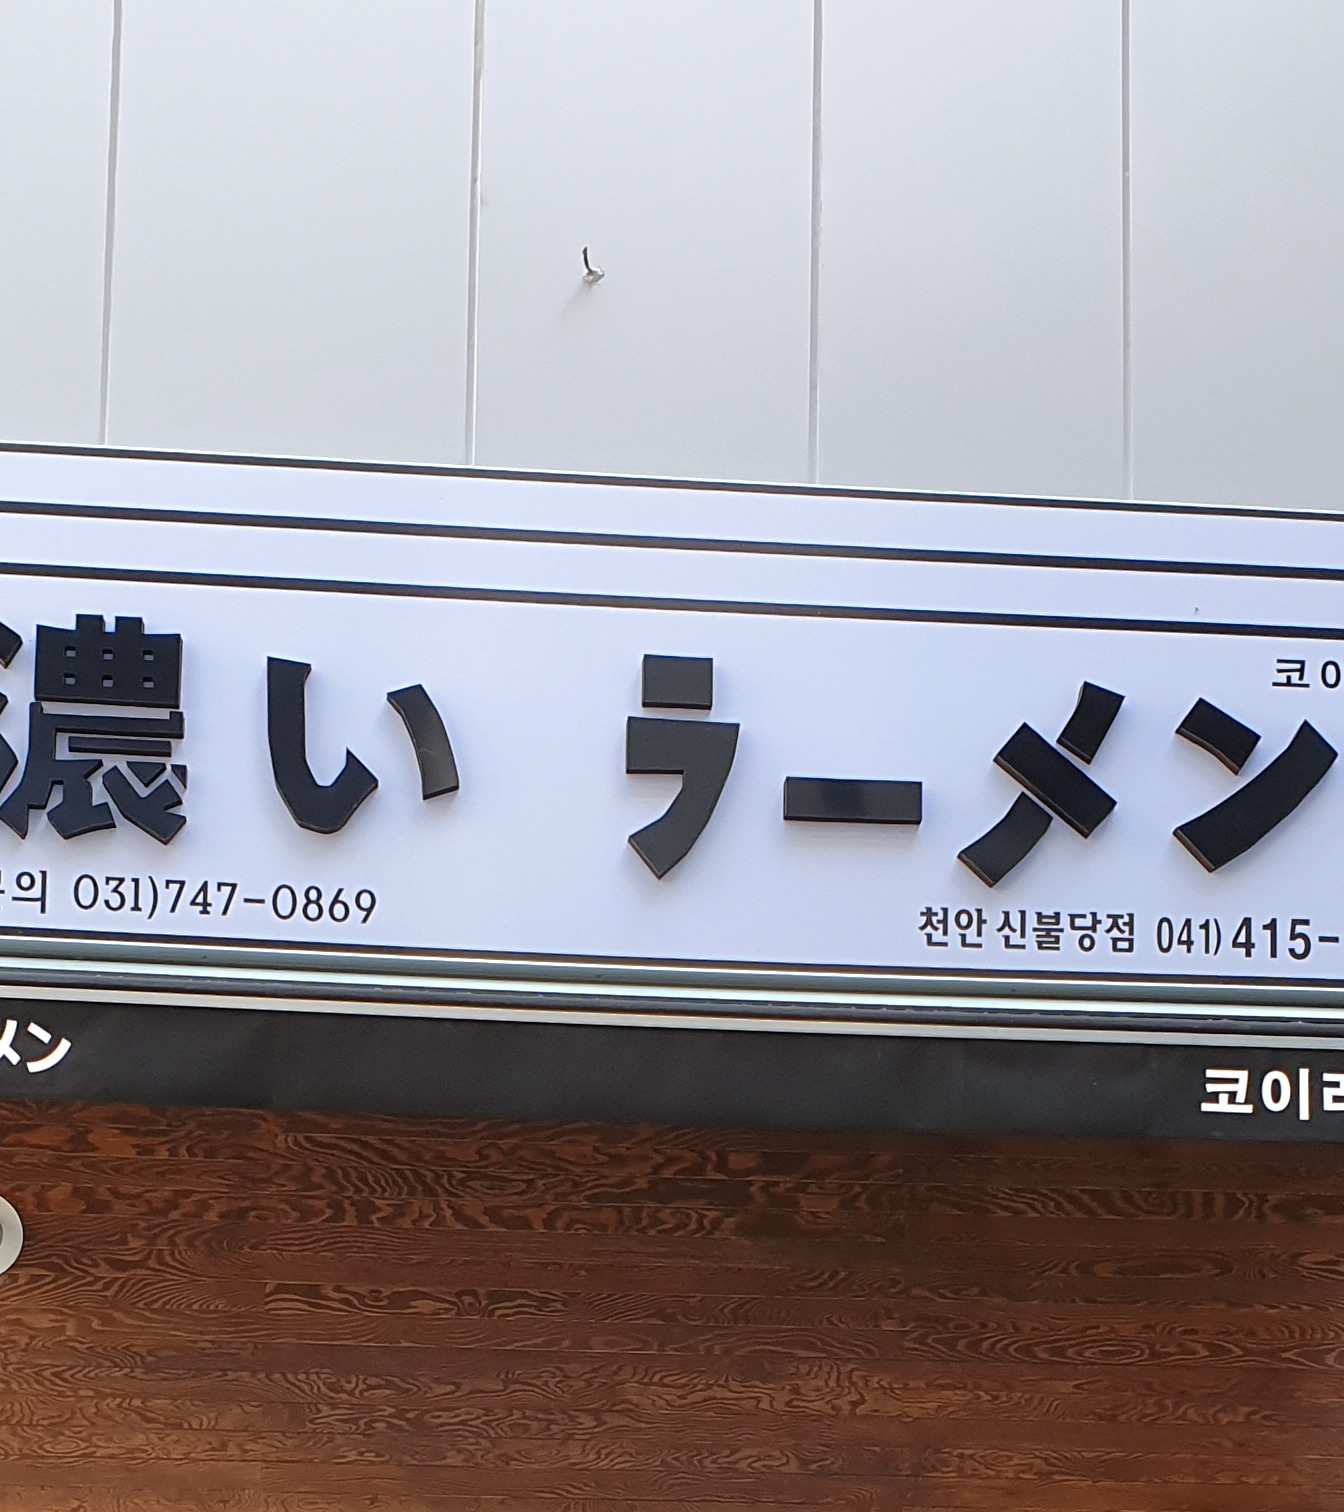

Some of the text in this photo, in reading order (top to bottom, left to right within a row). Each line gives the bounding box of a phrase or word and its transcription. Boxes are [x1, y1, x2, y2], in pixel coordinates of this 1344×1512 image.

[626, 653, 1341, 888] ラーメン
[73, 873, 377, 925] 031)747-0869
